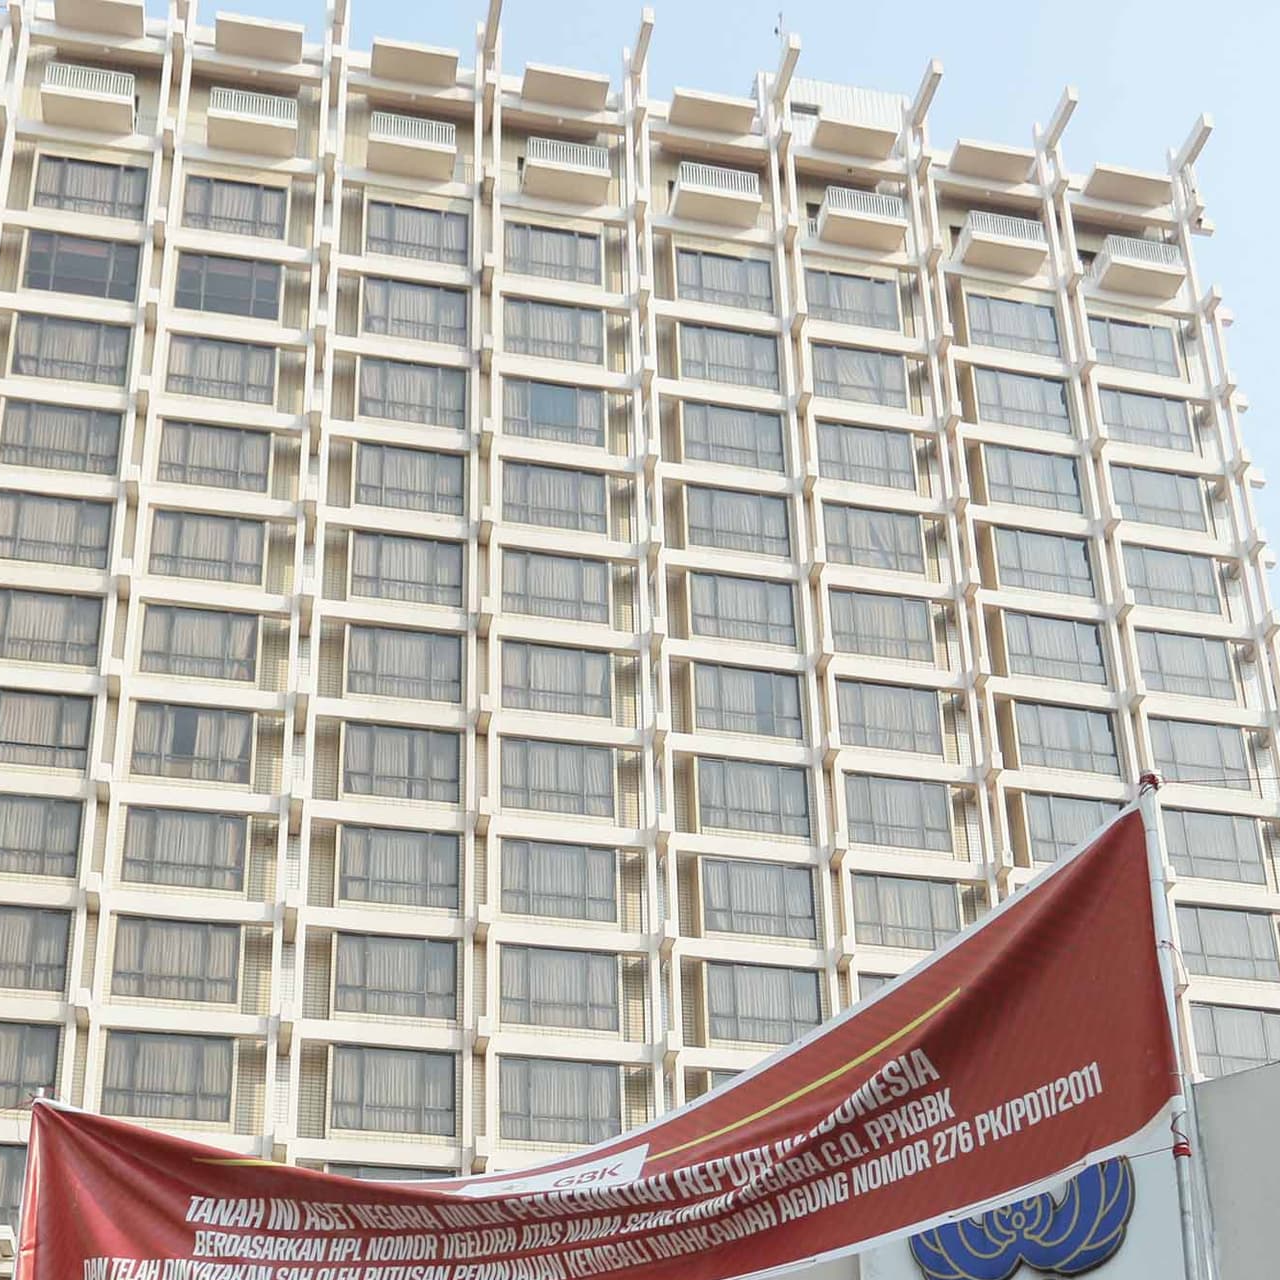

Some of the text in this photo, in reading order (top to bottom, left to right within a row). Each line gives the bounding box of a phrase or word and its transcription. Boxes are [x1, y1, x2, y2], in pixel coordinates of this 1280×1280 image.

[184, 1195, 265, 1228] TANAH
[267, 1197, 300, 1231] INI
[304, 1200, 356, 1231] ASET
[352, 1203, 444, 1231] NEGARA
[439, 1201, 515, 1228] MILIK
[504, 1172, 676, 1220] PEMERINTAH
[193, 1230, 326, 1262] BERDASARKAN
[328, 1237, 364, 1262] HPL
[365, 1233, 437, 1261] NOMOR
[518, 1221, 563, 1250] ATAS
[562, 1215, 622, 1244] NAMA
[738, 1152, 825, 1204] NEGARA
[864, 1087, 957, 1150] PPKGBK
[553, 1162, 623, 1188] GBK
[563, 1239, 652, 1280] KEMBALI
[650, 1202, 777, 1260] MAHKAMAH
[779, 1171, 850, 1224] AGUNG
[852, 1139, 932, 1197] NOMOR
[933, 1122, 974, 1163] 276
[974, 1061, 1104, 1147] PK/PDT/2011
